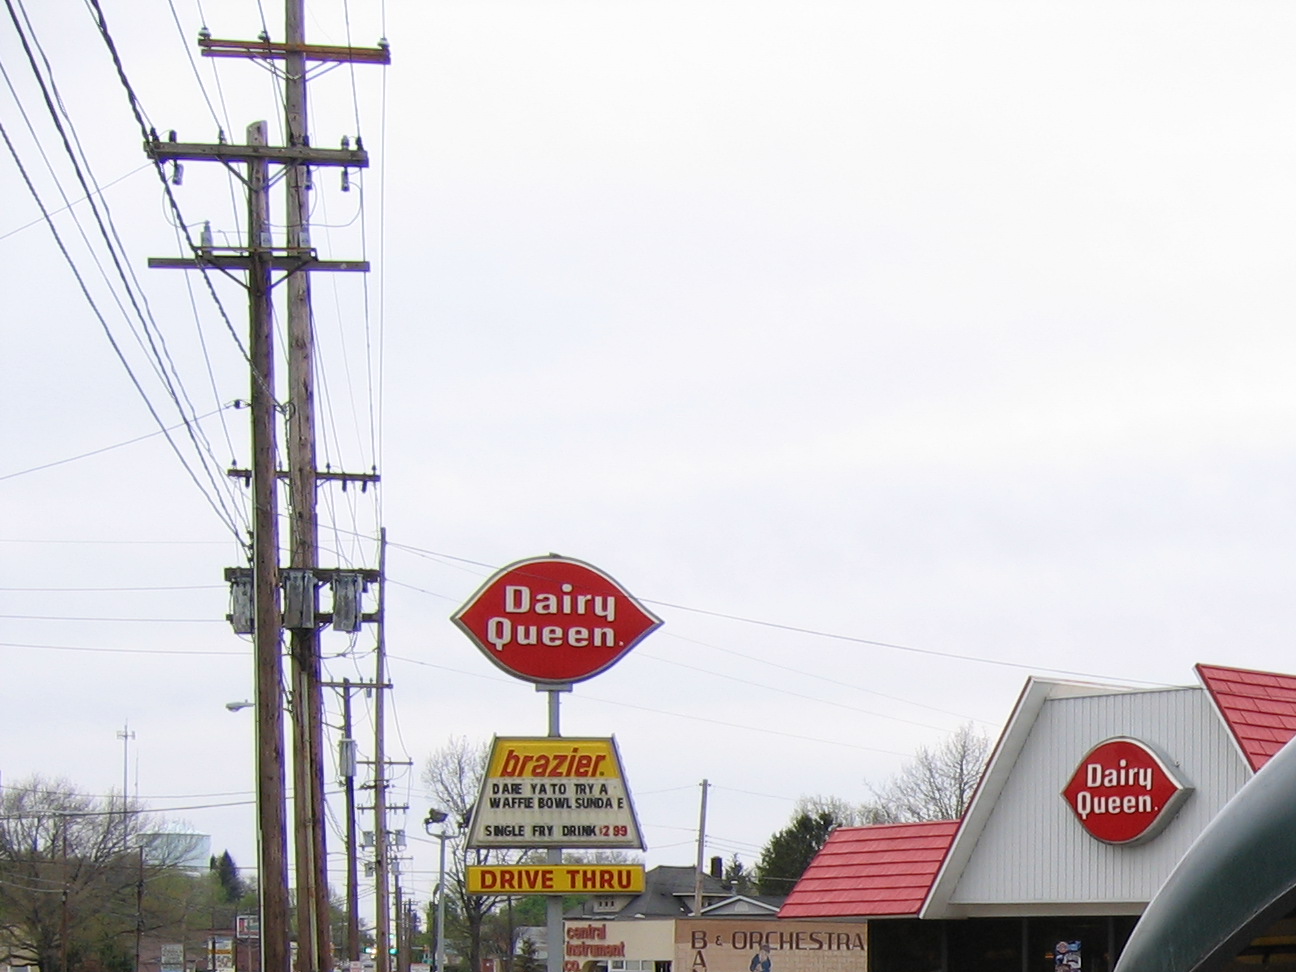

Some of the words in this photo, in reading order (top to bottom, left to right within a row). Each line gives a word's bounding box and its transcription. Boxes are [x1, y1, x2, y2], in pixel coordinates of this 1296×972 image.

[505, 583, 616, 622] Dairy
[487, 616, 615, 651] Queen
[499, 747, 607, 778] brazier
[1087, 759, 1153, 790] Dairy
[574, 783, 595, 795] TRY
[599, 783, 609, 795] A
[538, 797, 573, 809] BOWL
[1077, 791, 1152, 819] Queen
[485, 825, 525, 837] SINGLE
[533, 825, 554, 837] FRY
[562, 825, 597, 837] DRINK
[480, 870, 554, 890] DRIVE
[566, 870, 632, 890] THRU
[566, 923, 606, 940] central
[731, 931, 866, 951] ORCHESTRA
[566, 941, 625, 958] instrument
